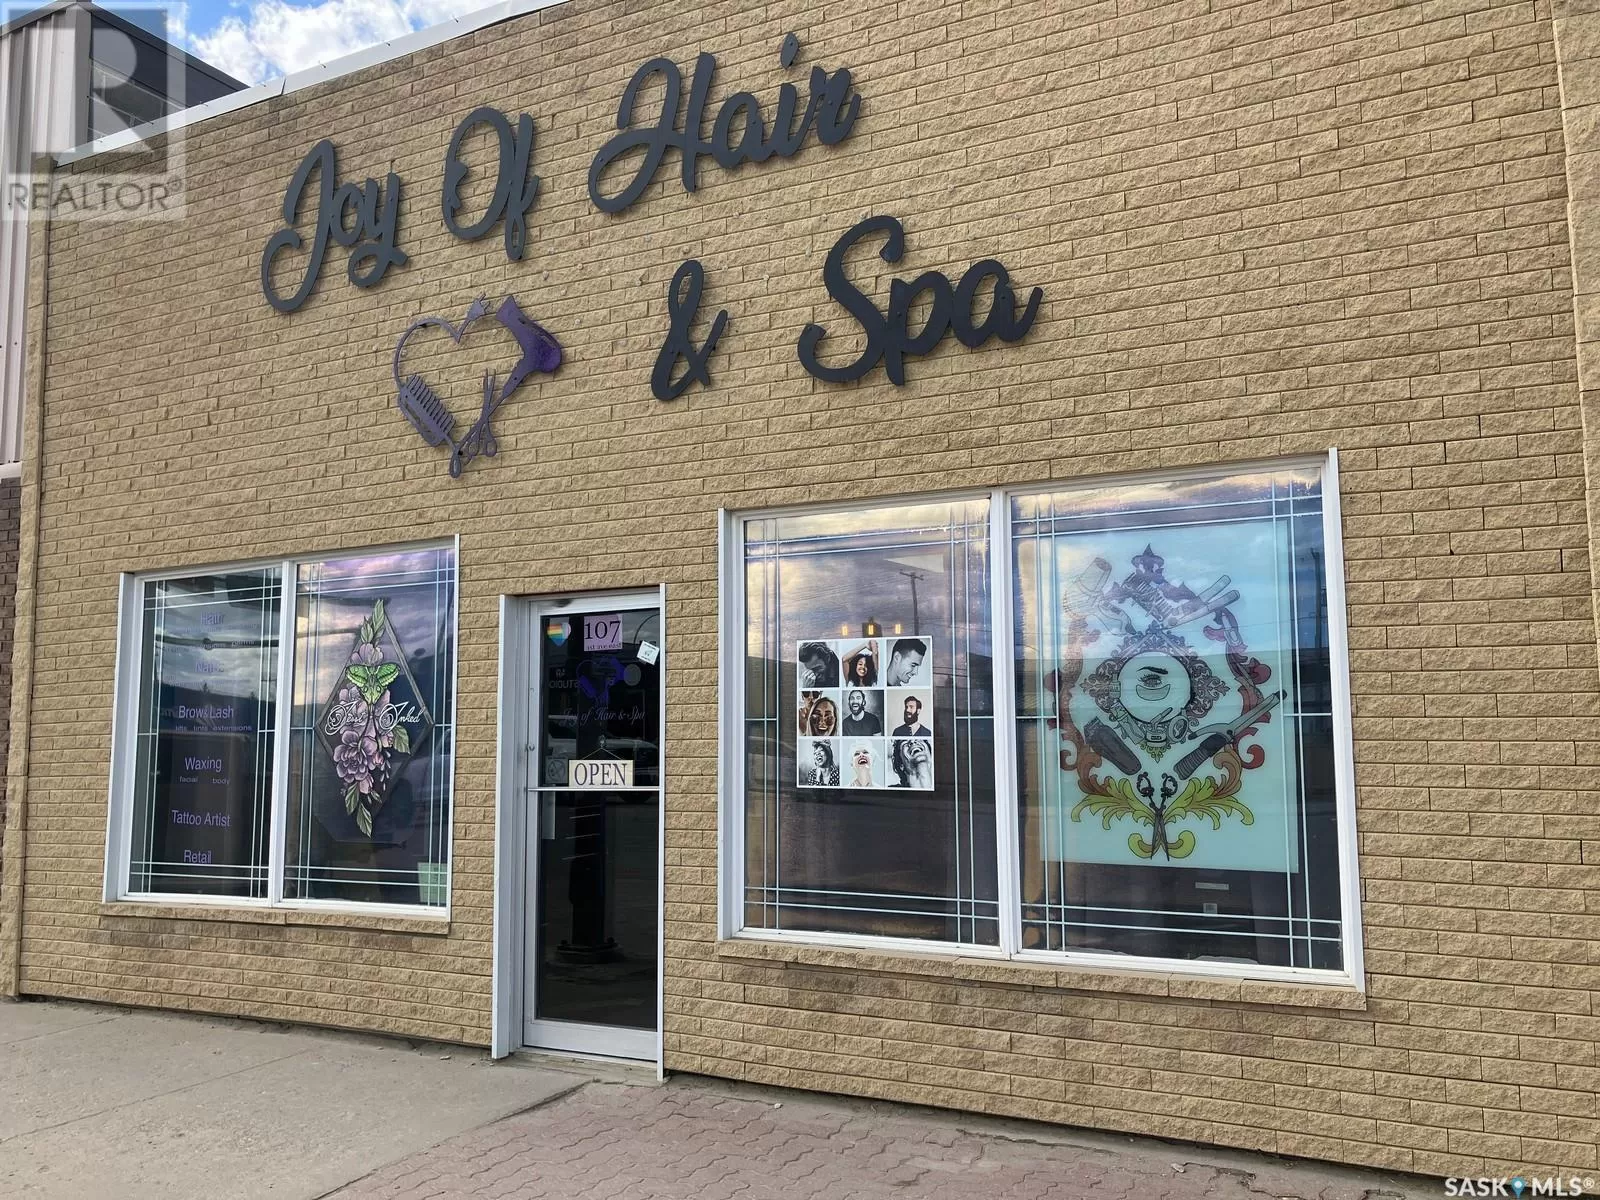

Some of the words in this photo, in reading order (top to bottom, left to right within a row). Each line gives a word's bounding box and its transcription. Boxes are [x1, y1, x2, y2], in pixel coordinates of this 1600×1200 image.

[262, 138, 408, 312] Joy
[441, 106, 540, 261] Of
[588, 31, 861, 214] Hair
[651, 259, 728, 402] &
[797, 214, 1043, 386] Spa
[584, 620, 621, 643] 107
[184, 756, 222, 773] Waxing
[574, 762, 628, 786] OPEN
[212, 777, 230, 786] body
[172, 809, 202, 826] Tattoo
[203, 812, 231, 827] Artist
[183, 849, 212, 864] Retail
